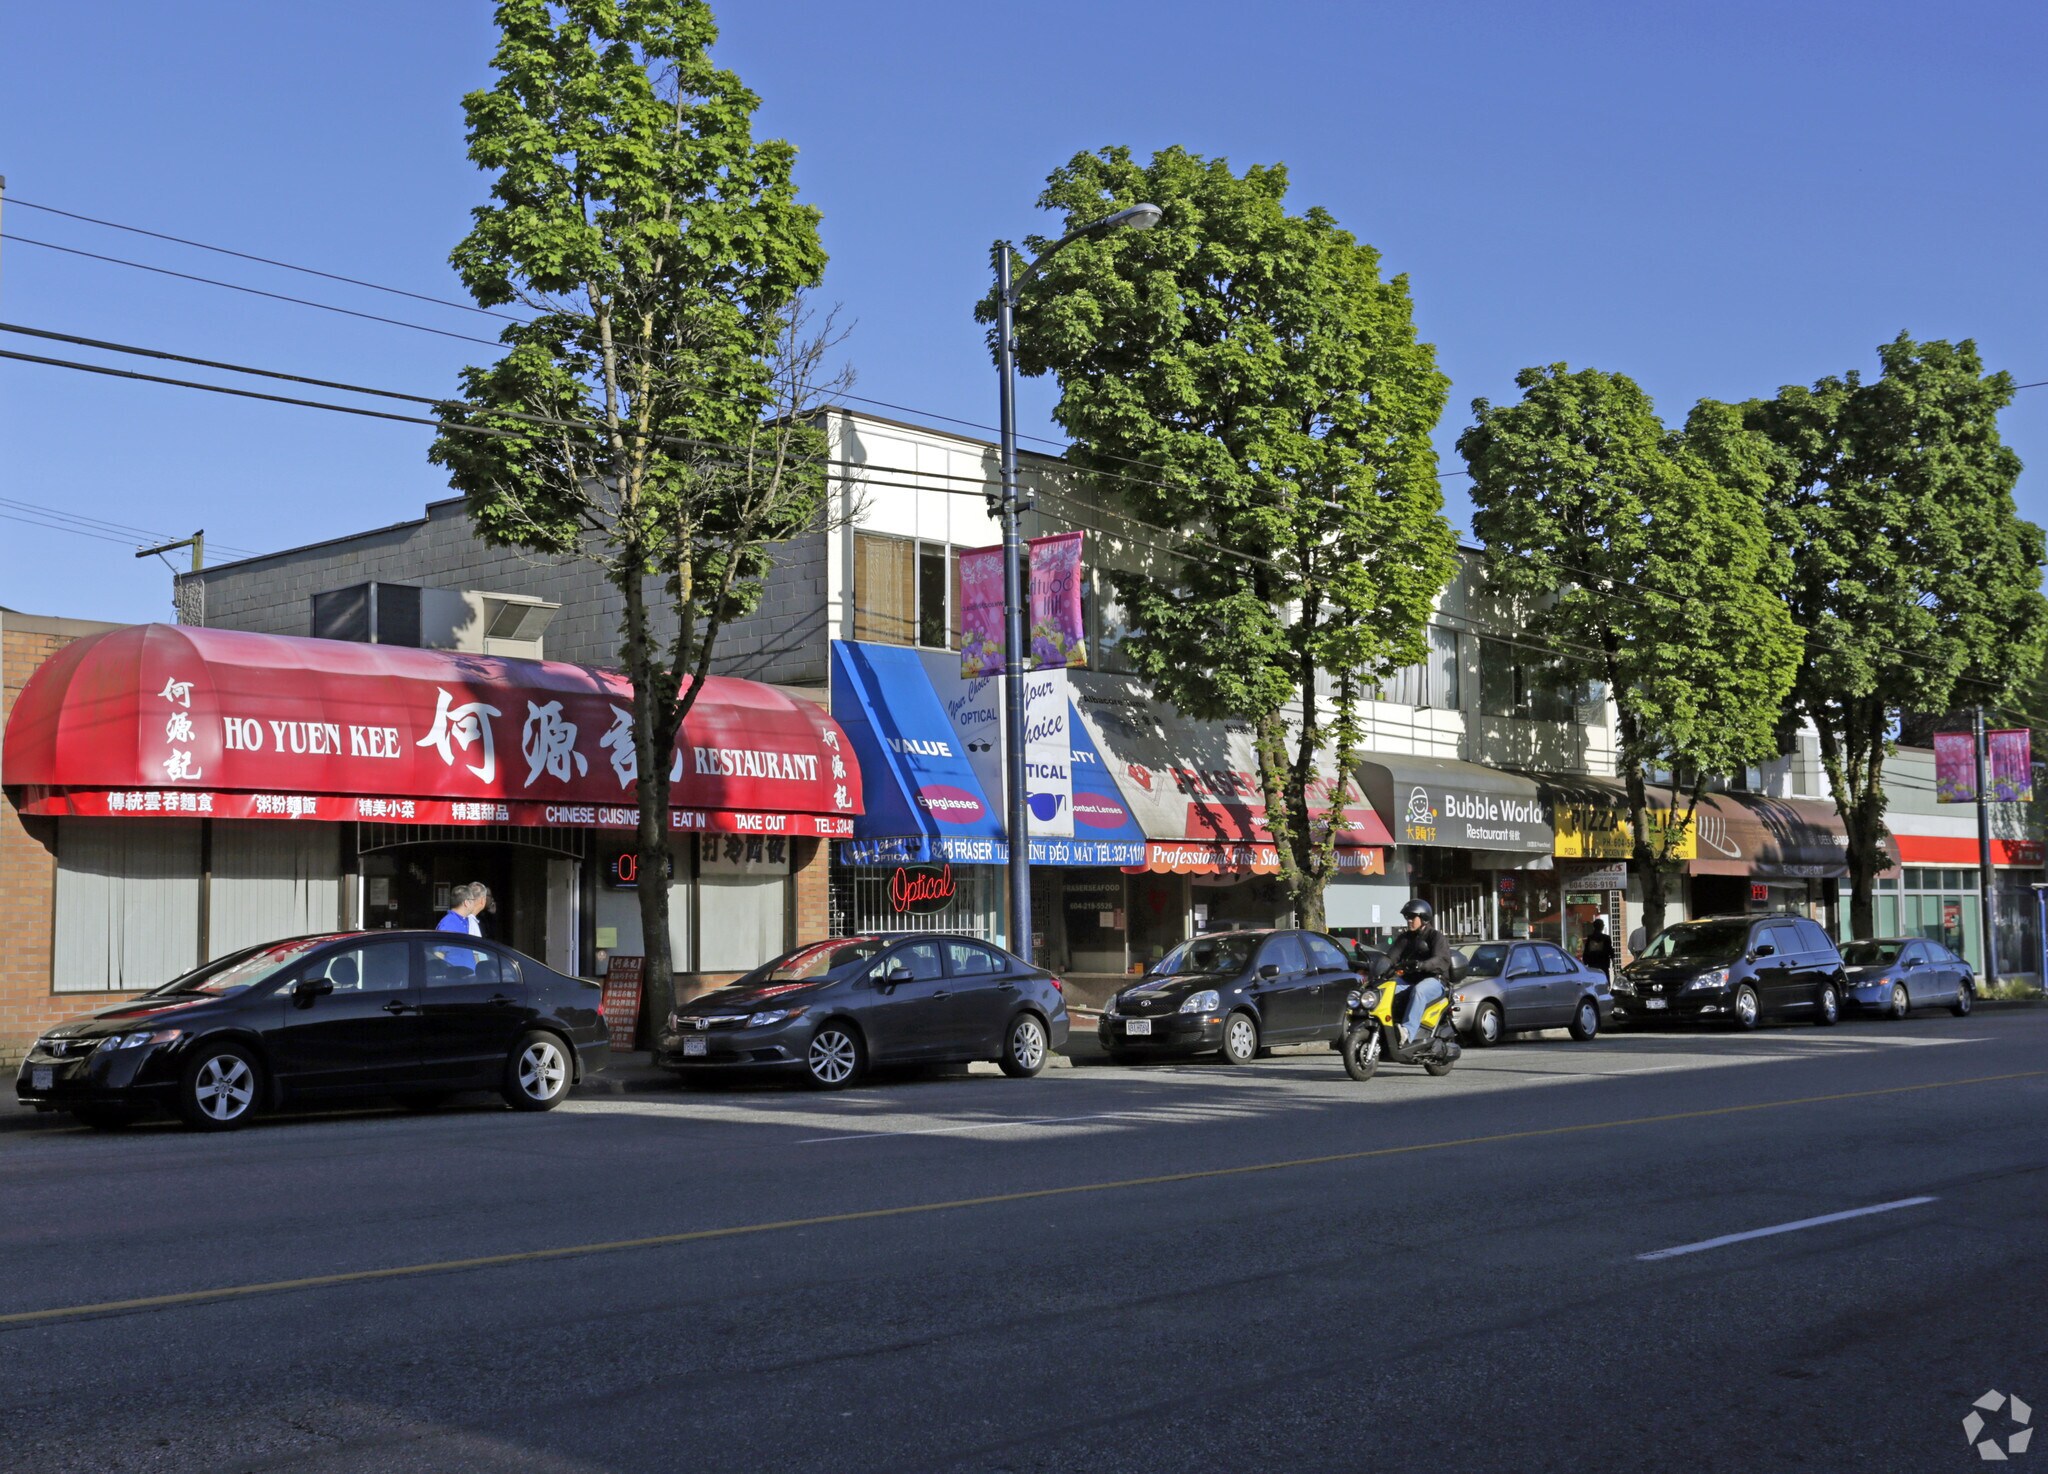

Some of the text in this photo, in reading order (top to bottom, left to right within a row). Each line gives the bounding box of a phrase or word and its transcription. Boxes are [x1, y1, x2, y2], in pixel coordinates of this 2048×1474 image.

[960, 707, 998, 726] OPTICAL
[158, 676, 202, 782] 何源記
[223, 717, 401, 759] HO YUEN KEE
[1024, 714, 1064, 745] hoice
[886, 737, 952, 757] VALUE
[1071, 750, 1096, 764] LITY
[693, 747, 818, 781] RESTAURANT
[822, 727, 852, 810] 何源記
[1026, 764, 1067, 780] TICAL
[1169, 767, 1264, 799] FRASER
[358, 798, 415, 818] 精美小菜
[451, 802, 509, 821] 精選甜品
[917, 795, 979, 811] Eyeglasses
[1073, 804, 1122, 816] ontact Lenses
[1445, 795, 1542, 824] Bubble World
[545, 805, 706, 828] CHINESE CUISINE EAT IN
[735, 814, 786, 831] TAKE OUT
[814, 818, 835, 833] TEL:
[1571, 809, 1619, 832] PIZZA
[1405, 824, 1437, 841] 大頭仔
[1466, 823, 1508, 841] Restaurant
[873, 853, 915, 863] OPTICAL
[955, 841, 992, 860] FRASER
[1152, 845, 1228, 869] Professional
[1331, 850, 1374, 871] Quality!
[892, 863, 956, 913] Optical
